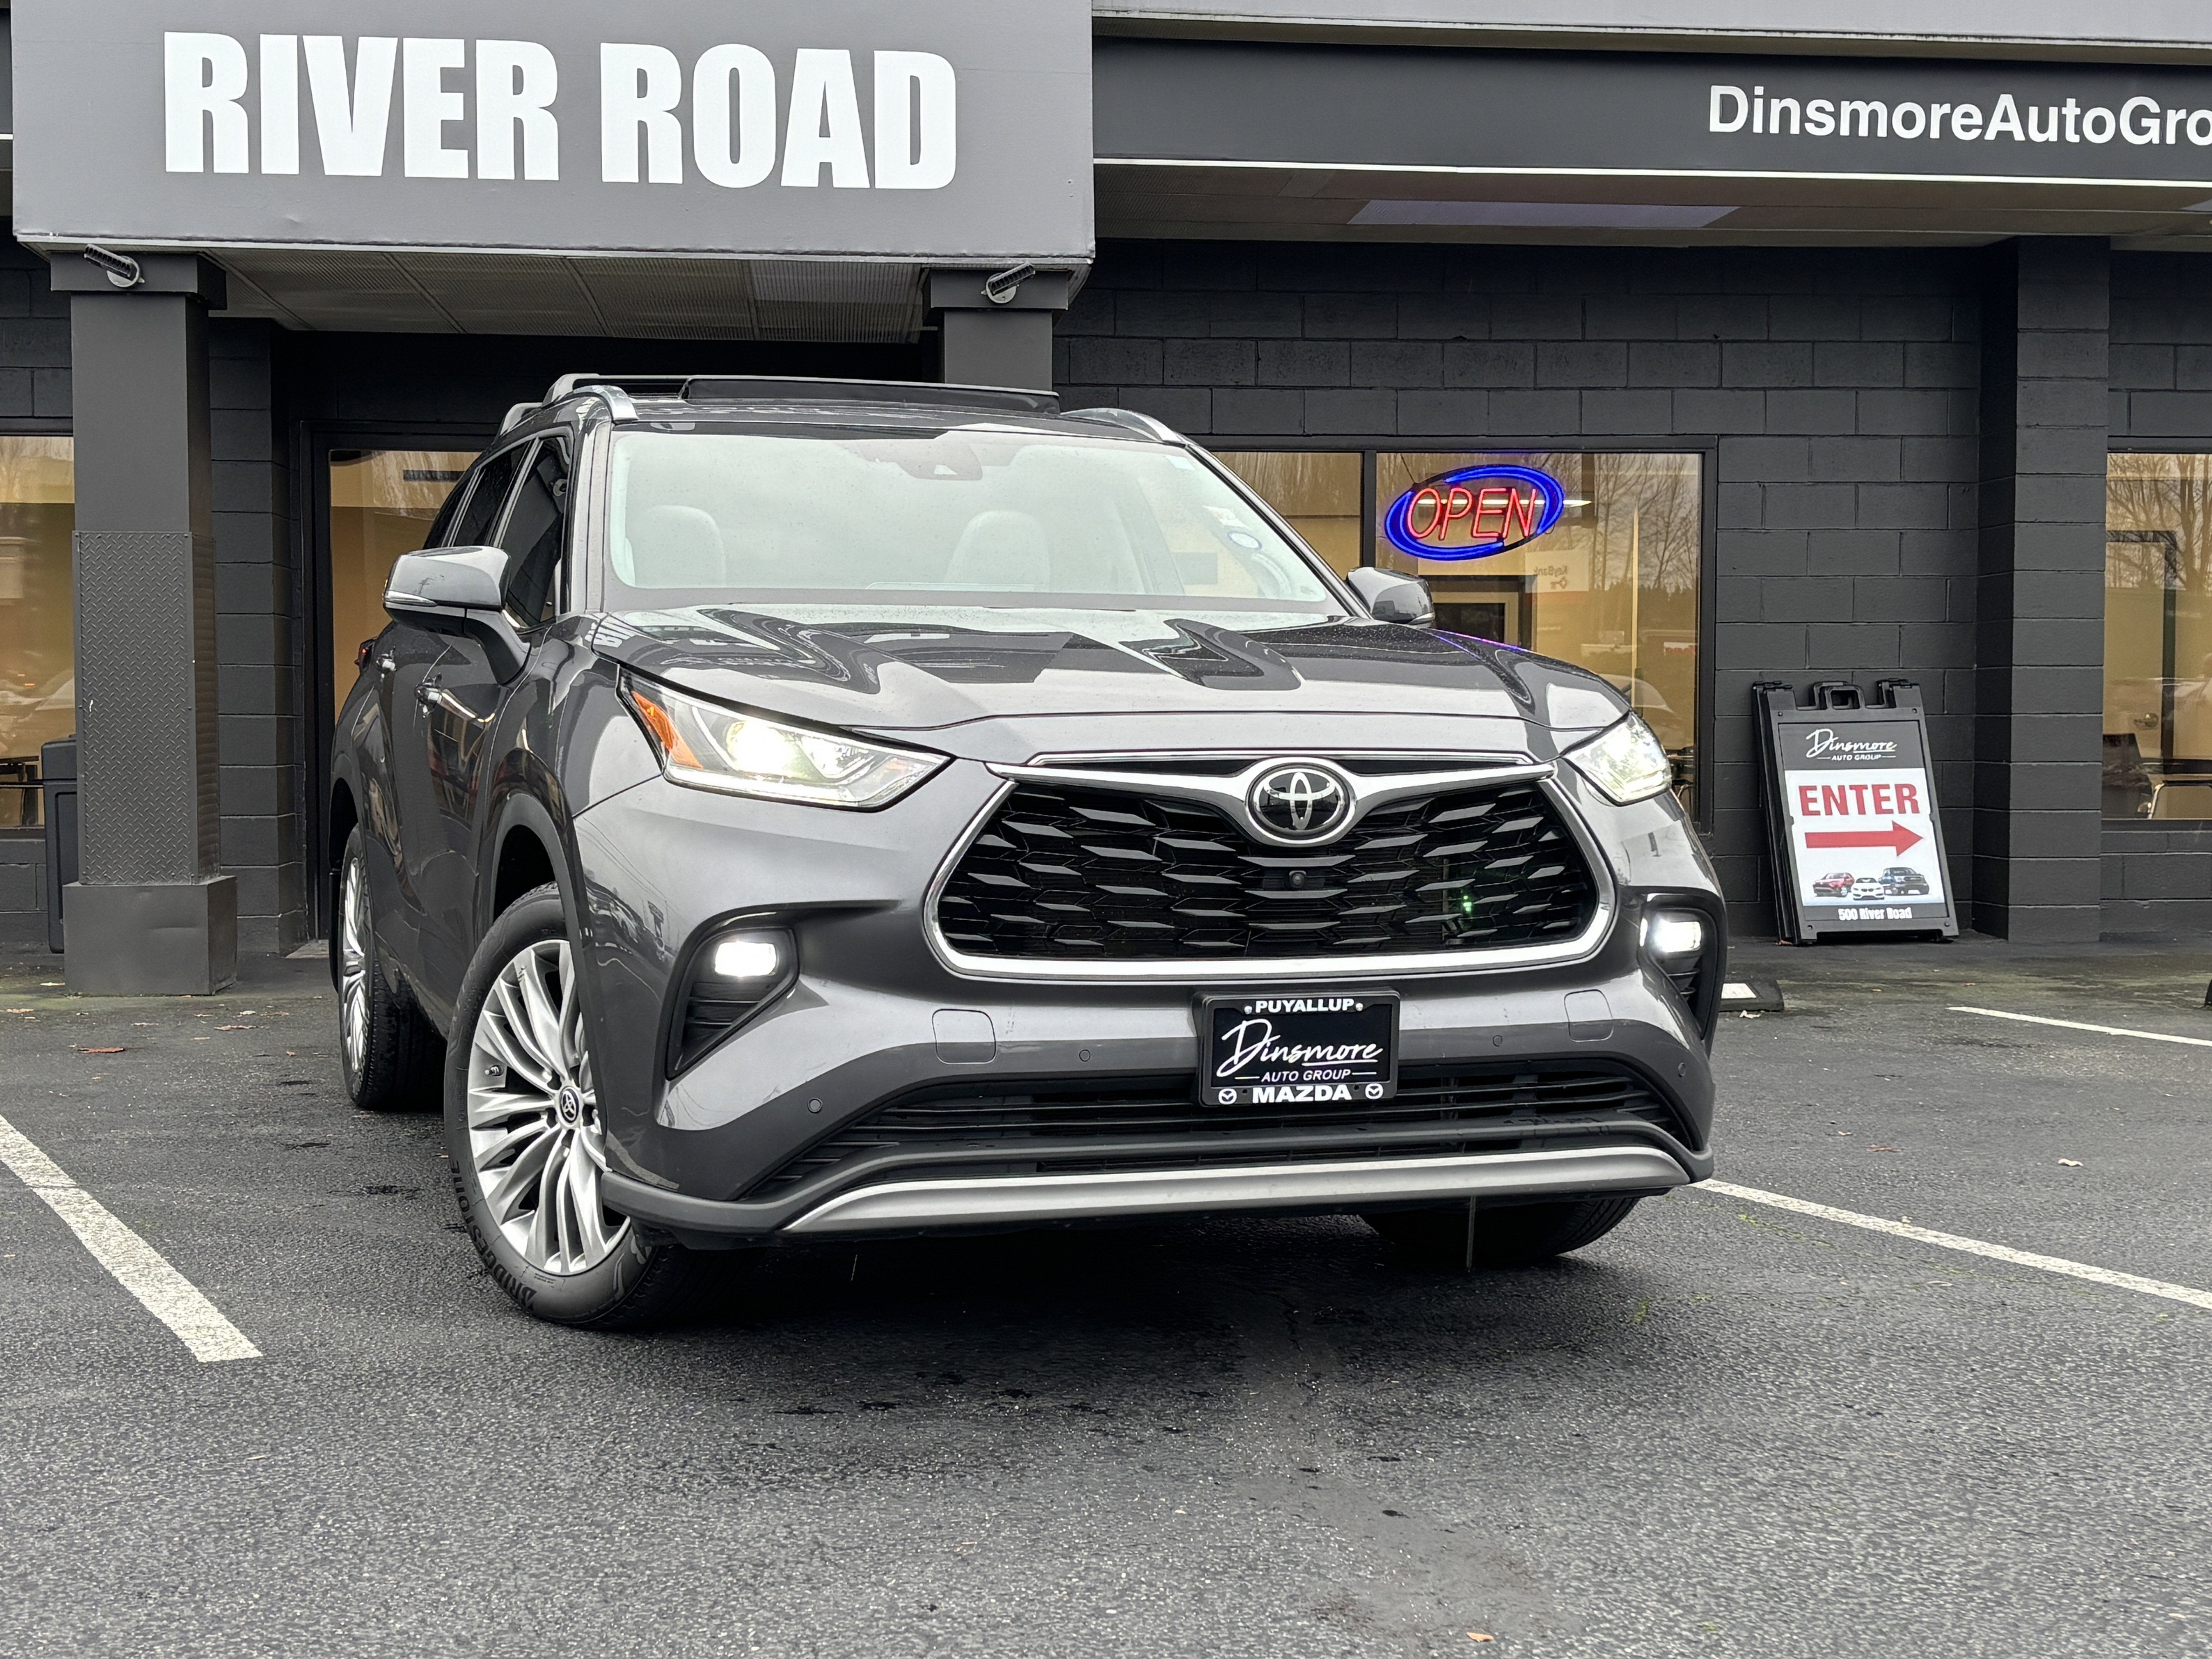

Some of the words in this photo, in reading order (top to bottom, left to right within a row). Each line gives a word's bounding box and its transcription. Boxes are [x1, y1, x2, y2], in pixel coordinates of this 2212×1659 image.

[164, 32, 559, 181] RIVER
[600, 43, 957, 190] ROAD
[1407, 487, 1537, 541] OPEN
[1806, 728, 1898, 758] Dinsmore
[1798, 783, 1920, 816] ENTER
[1838, 908, 1857, 921] 500
[1859, 907, 1885, 920] River
[1886, 907, 1912, 919] Road
[1255, 998, 1354, 1013] PUYALLUP
[1216, 1018, 1383, 1077] Dinsmore
[1261, 1072, 1298, 1082] AUTO
[1303, 1069, 1351, 1080] GROUP
[1252, 1084, 1352, 1104] MAZDA
